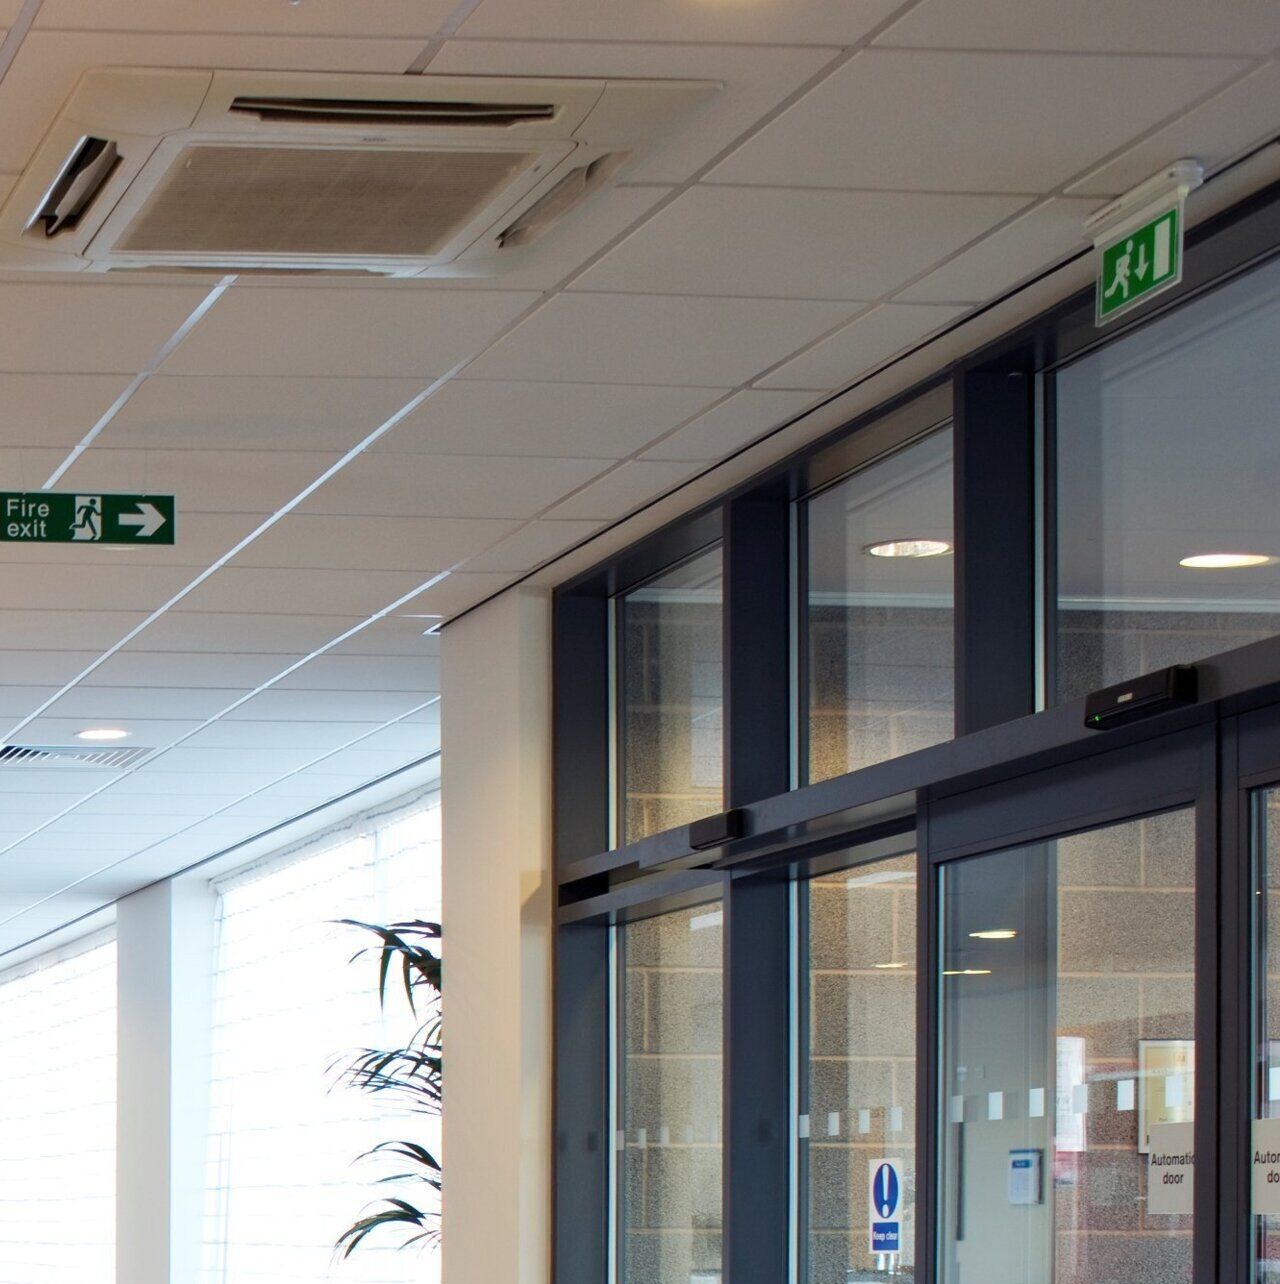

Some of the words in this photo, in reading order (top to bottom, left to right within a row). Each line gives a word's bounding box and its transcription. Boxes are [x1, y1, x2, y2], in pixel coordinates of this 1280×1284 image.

[6, 498, 50, 517] Fire
[6, 519, 47, 537] exit
[1162, 1171, 1184, 1185] door
